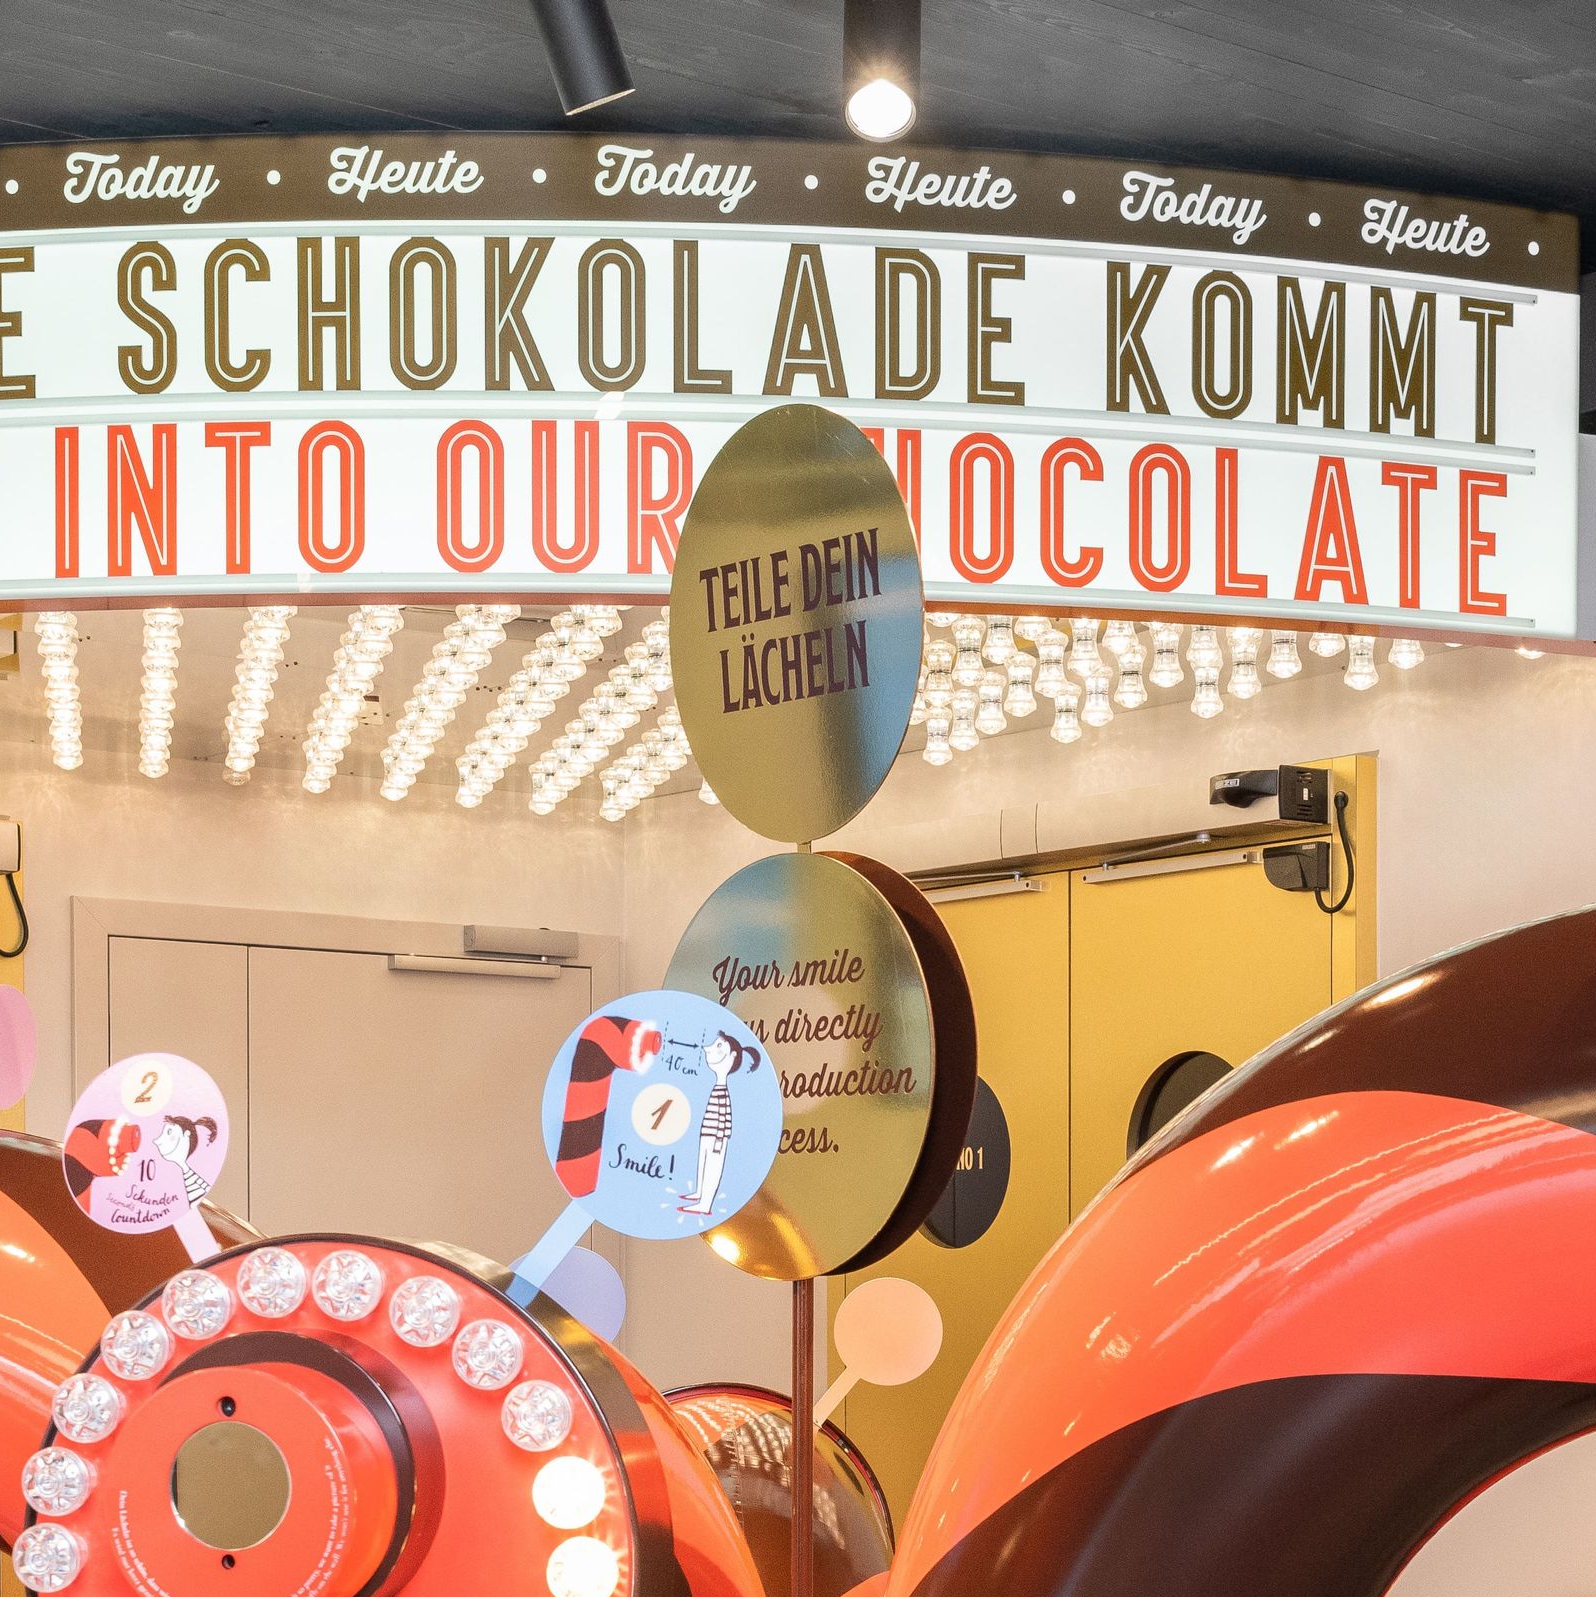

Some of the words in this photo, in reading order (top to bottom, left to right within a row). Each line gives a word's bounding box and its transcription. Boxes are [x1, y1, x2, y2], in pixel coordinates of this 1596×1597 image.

[64, 151, 220, 213] Today
[327, 145, 484, 202] Heute
[595, 144, 756, 214] Today
[866, 156, 1017, 212] Heute
[1120, 171, 1267, 246] Today
[1361, 199, 1491, 257] Heute
[117, 236, 1025, 406] SCHOKOLADE
[1106, 260, 1514, 446] KOMMT
[55, 419, 365, 578] INTO
[436, 419, 694, 575] OUR
[698, 549, 792, 633] TEILE
[798, 527, 883, 612] DEIN
[719, 620, 870, 714] LÄCHELN
[712, 954, 786, 1008] Your
[787, 948, 866, 986] smile
[774, 1003, 883, 1054] directly
[134, 1071, 159, 1103] 2
[779, 1063, 917, 1100] roduction
[650, 1098, 673, 1130] 1
[139, 1159, 156, 1182] 10
[977, 1147, 983, 1169] 1
[111, 1208, 170, 1223] Countdown
[125, 1184, 179, 1206] Sekunden
